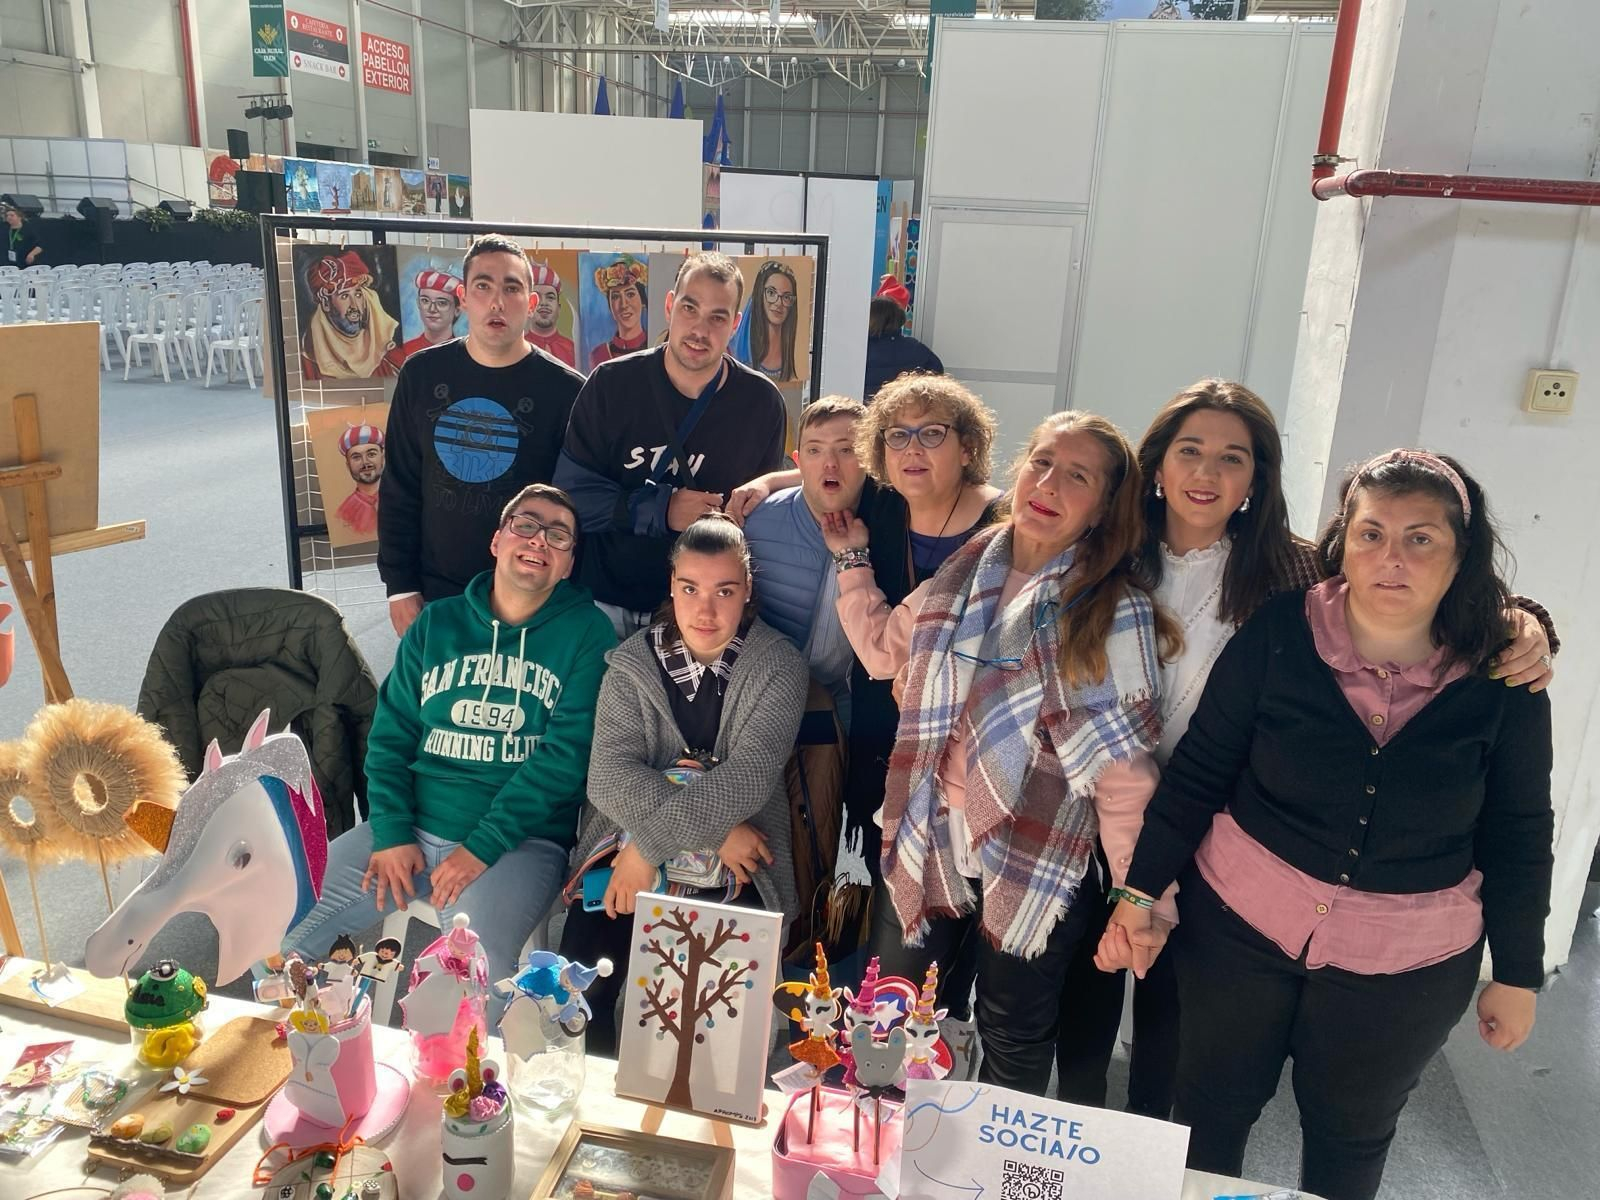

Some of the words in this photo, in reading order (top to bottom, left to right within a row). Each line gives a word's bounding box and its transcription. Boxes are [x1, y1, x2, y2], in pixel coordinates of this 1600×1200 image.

[367, 37, 404, 60] ACCESO
[365, 68, 410, 92] EXTERIOR
[421, 658, 458, 706] SAN
[458, 653, 563, 717] FRANCISC
[459, 703, 515, 729] 1994
[424, 728, 496, 762] RUNNING
[991, 1103, 1084, 1141] HAZTE
[978, 1124, 1101, 1165] SOCIA/O
